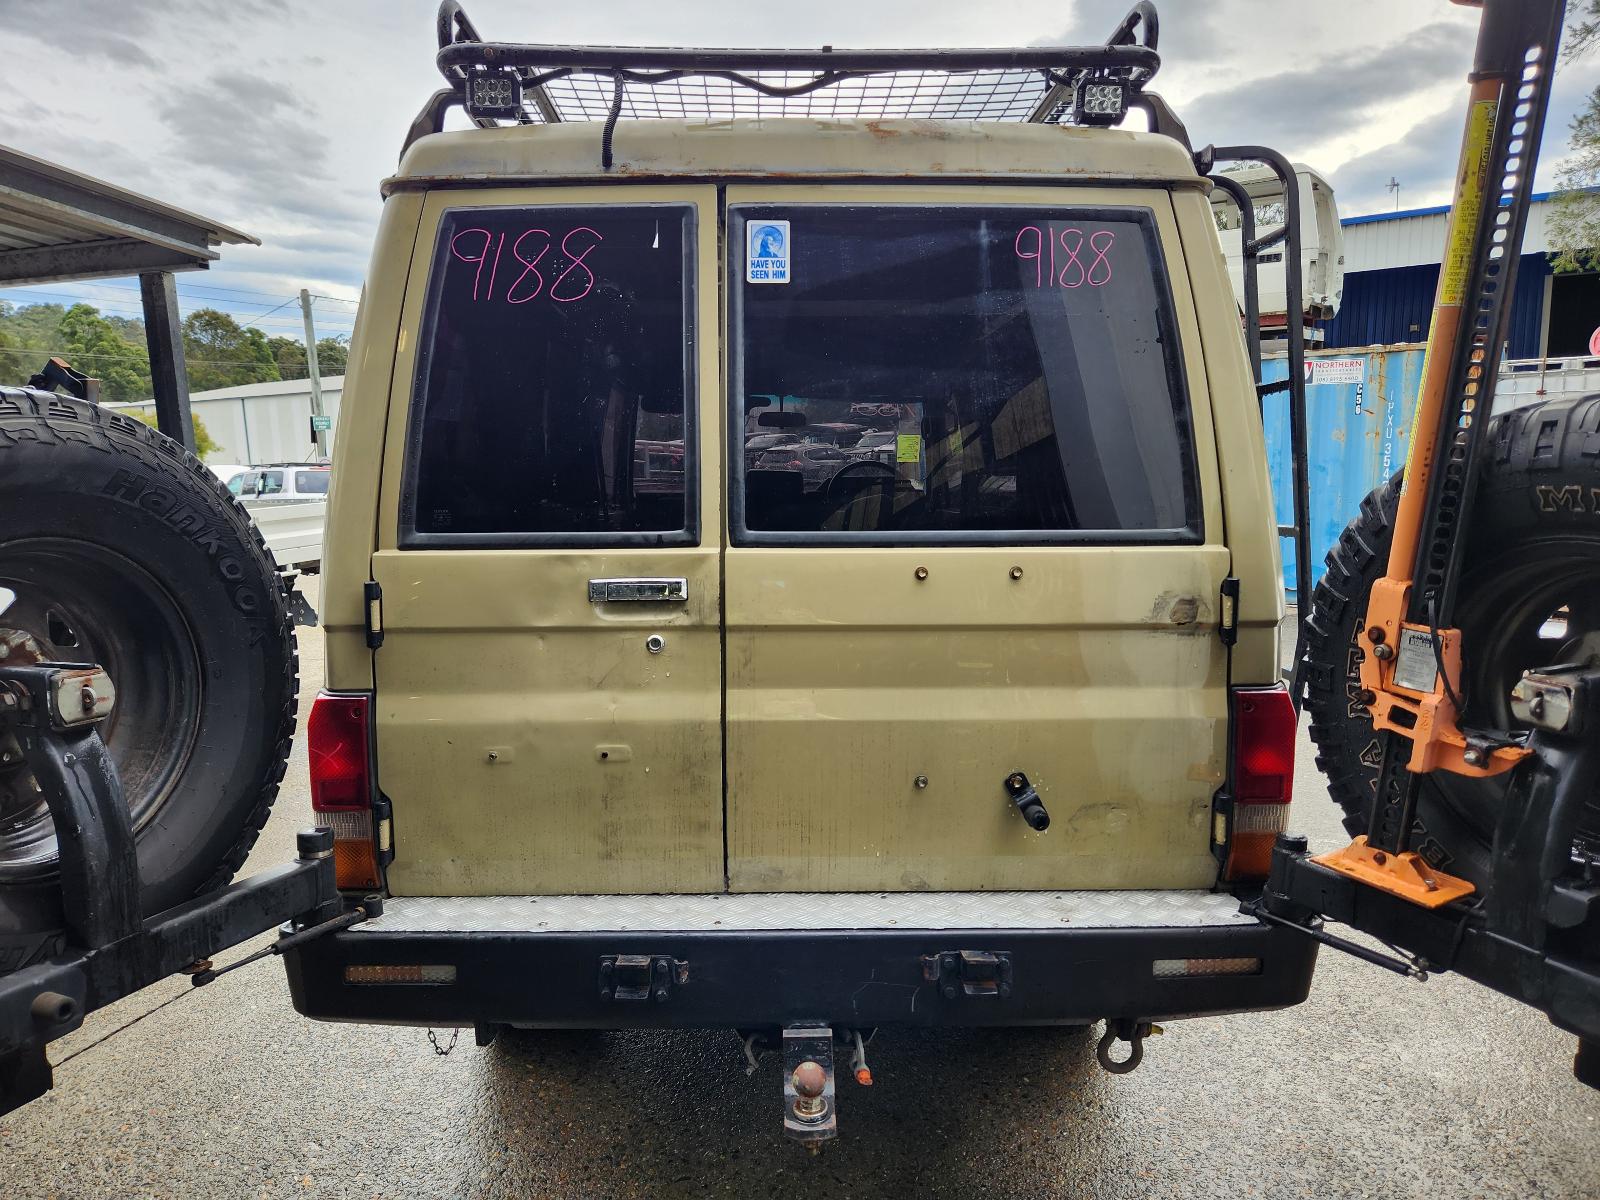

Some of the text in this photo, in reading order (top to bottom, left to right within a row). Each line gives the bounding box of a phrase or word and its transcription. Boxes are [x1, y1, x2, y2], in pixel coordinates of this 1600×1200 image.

[1015, 226, 1115, 288] 9188
[452, 227, 602, 303] 9188
[751, 260, 786, 269] HAVE YOU
[751, 270, 786, 279] SEEN HIM
[1315, 360, 1362, 369] NORTHERN
